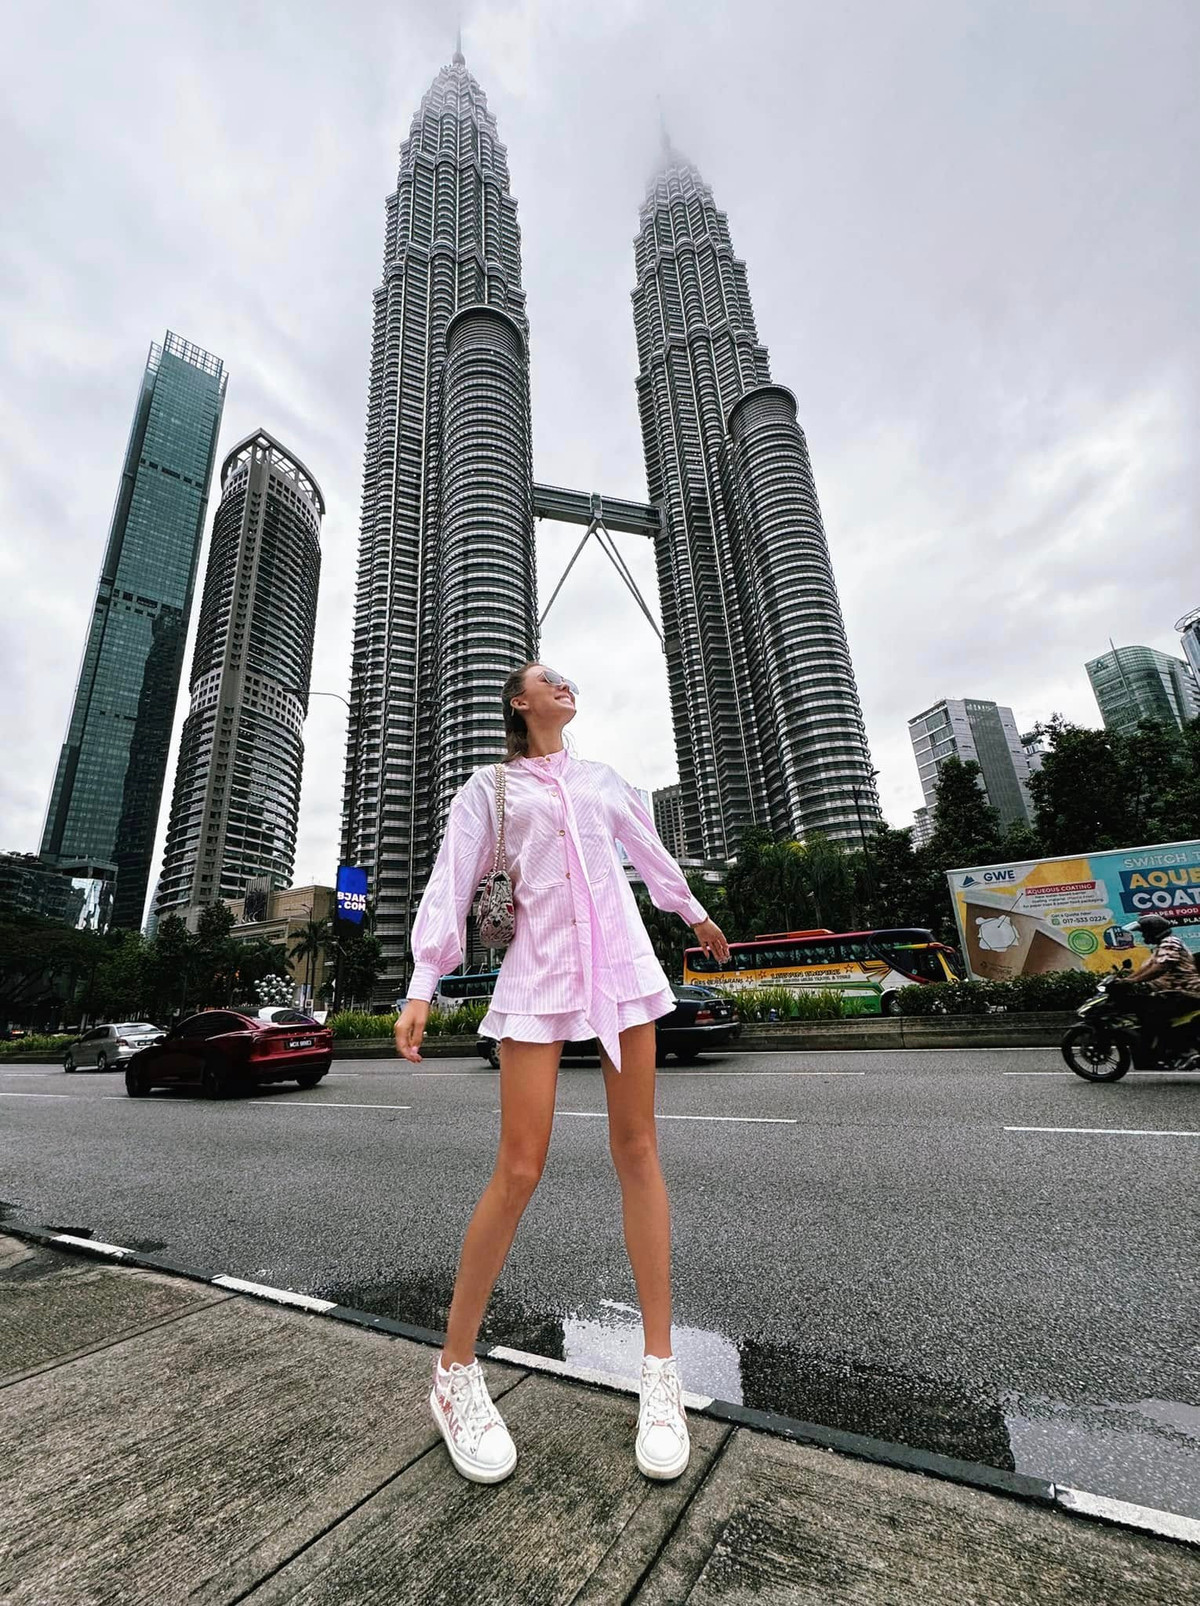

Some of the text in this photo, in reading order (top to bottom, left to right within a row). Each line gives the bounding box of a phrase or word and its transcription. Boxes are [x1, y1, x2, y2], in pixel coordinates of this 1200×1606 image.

[1124, 853, 1187, 868] SWITCH
[983, 869, 1015, 882] GWE
[1027, 883, 1092, 895] AQUEOUS COATING
[337, 891, 366, 903] BJAK
[1176, 907, 1199, 915] FOOD
